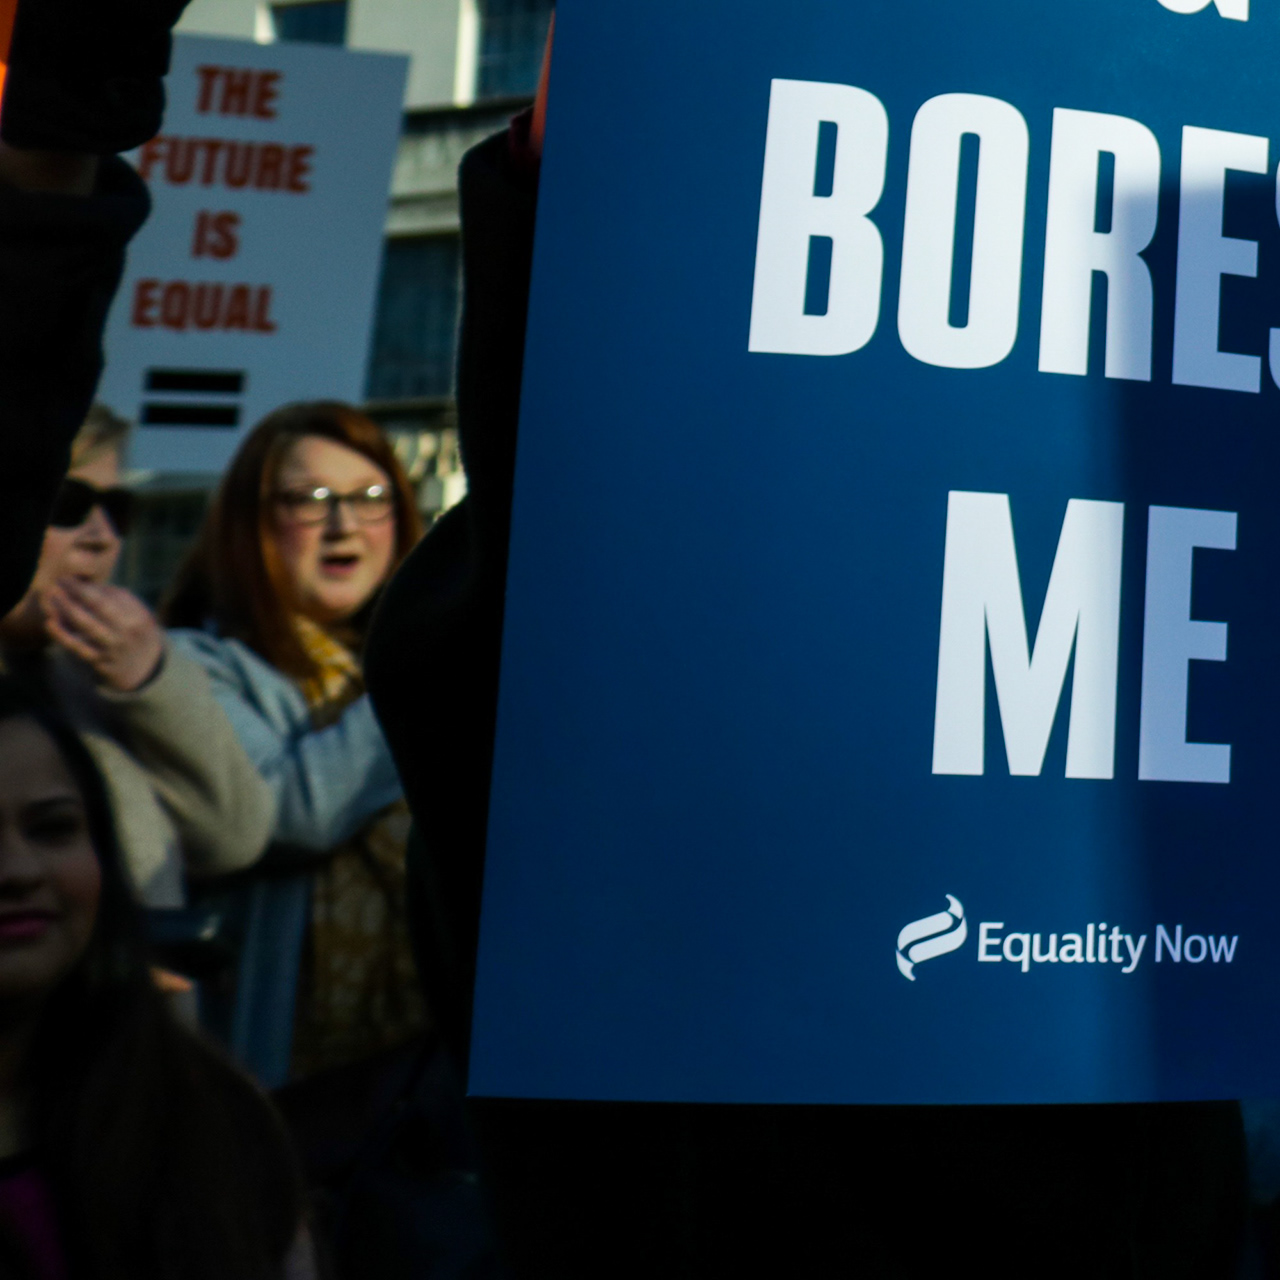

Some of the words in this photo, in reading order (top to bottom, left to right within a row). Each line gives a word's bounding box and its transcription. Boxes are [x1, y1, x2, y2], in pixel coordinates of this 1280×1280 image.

[195, 64, 284, 121] THE
[138, 135, 315, 194] FUTURE
[190, 208, 243, 261] IS
[129, 277, 278, 334] EQUAL
[931, 490, 1239, 784] ME
[977, 922, 1148, 975] Equality
[1154, 925, 1239, 964] Now
